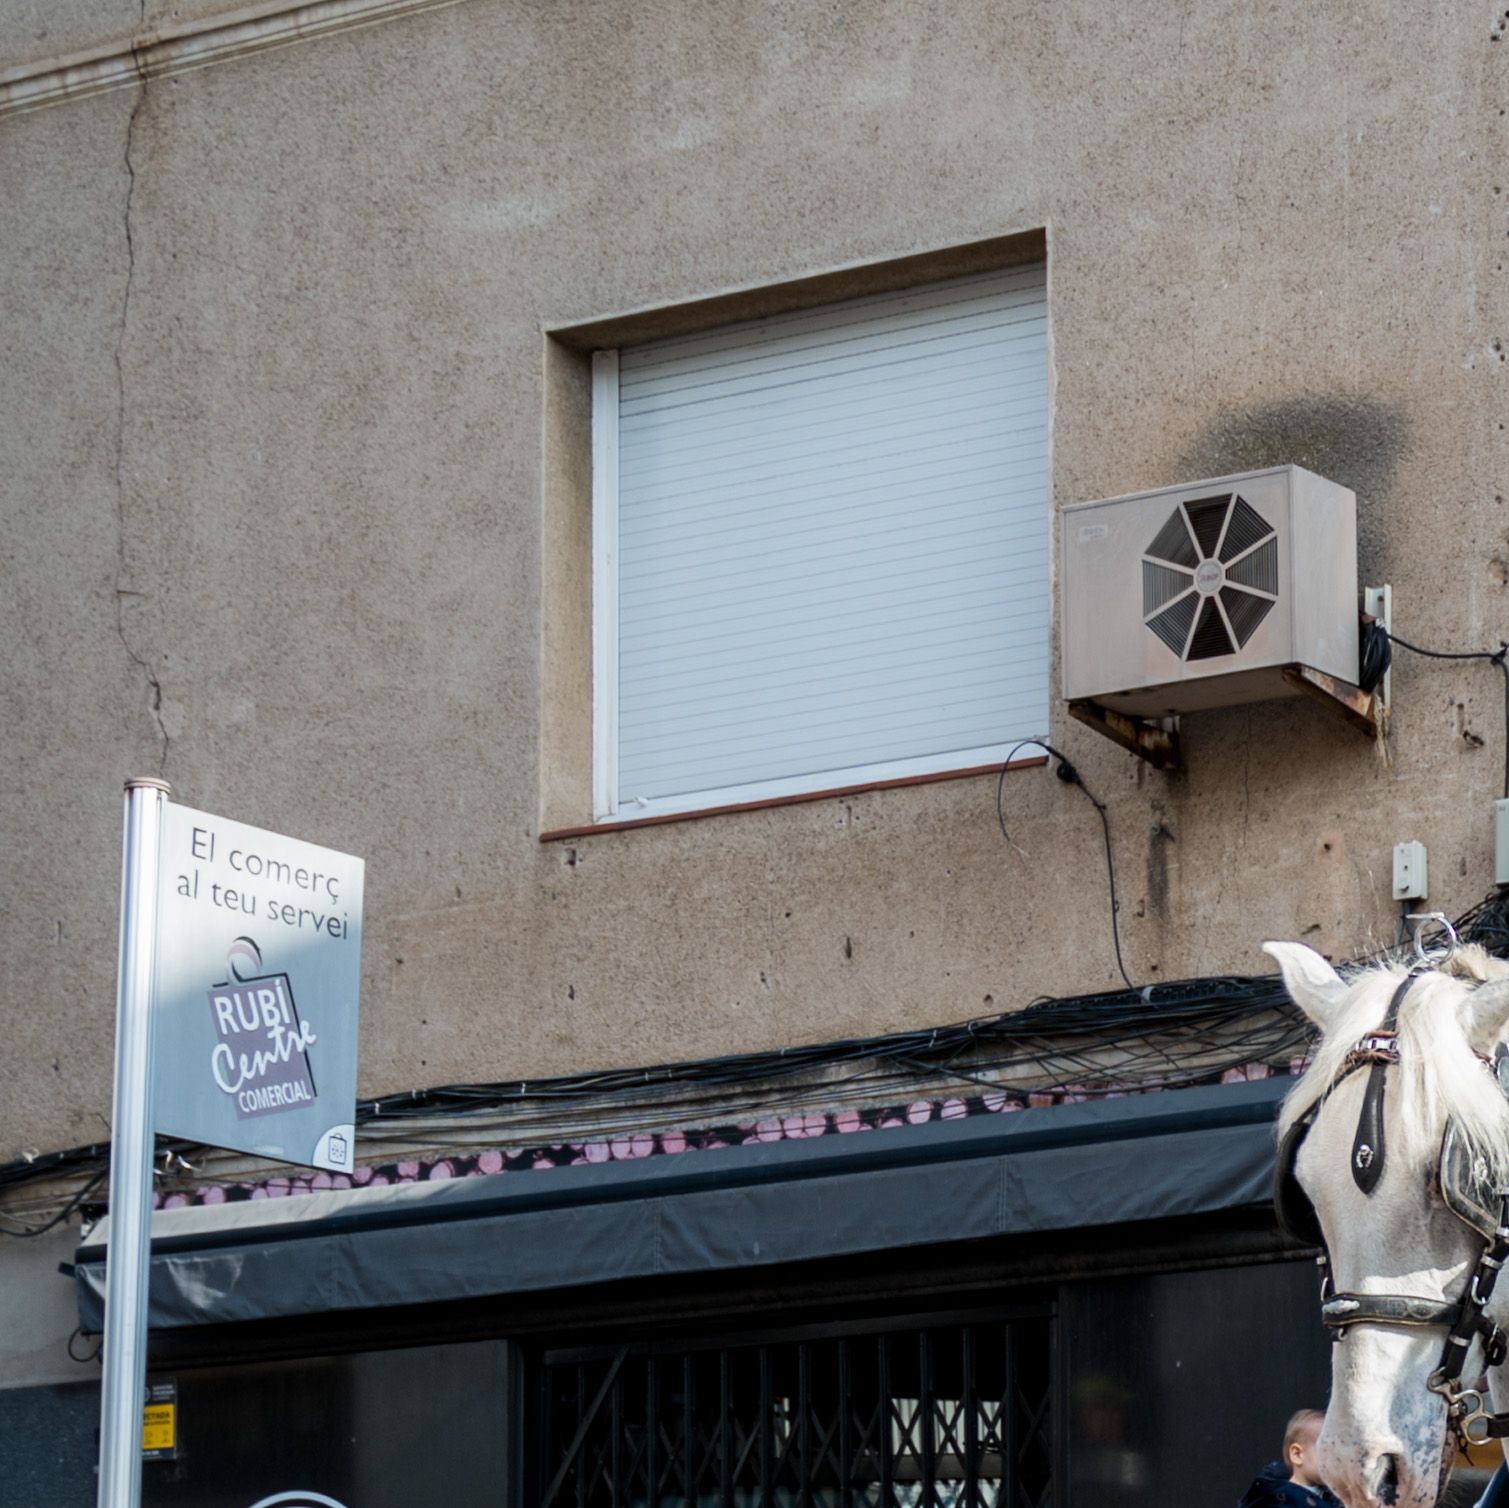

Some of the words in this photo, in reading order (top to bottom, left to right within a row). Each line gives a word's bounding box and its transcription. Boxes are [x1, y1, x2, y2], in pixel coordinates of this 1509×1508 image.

[192, 827, 215, 862] El
[229, 849, 339, 905] comerç
[177, 869, 199, 899] al
[212, 884, 256, 916] teu
[267, 900, 348, 940] servei
[214, 979, 290, 1035] RUBÍ
[211, 1020, 317, 1093] Centre
[238, 1080, 312, 1112] COMERCIAL
